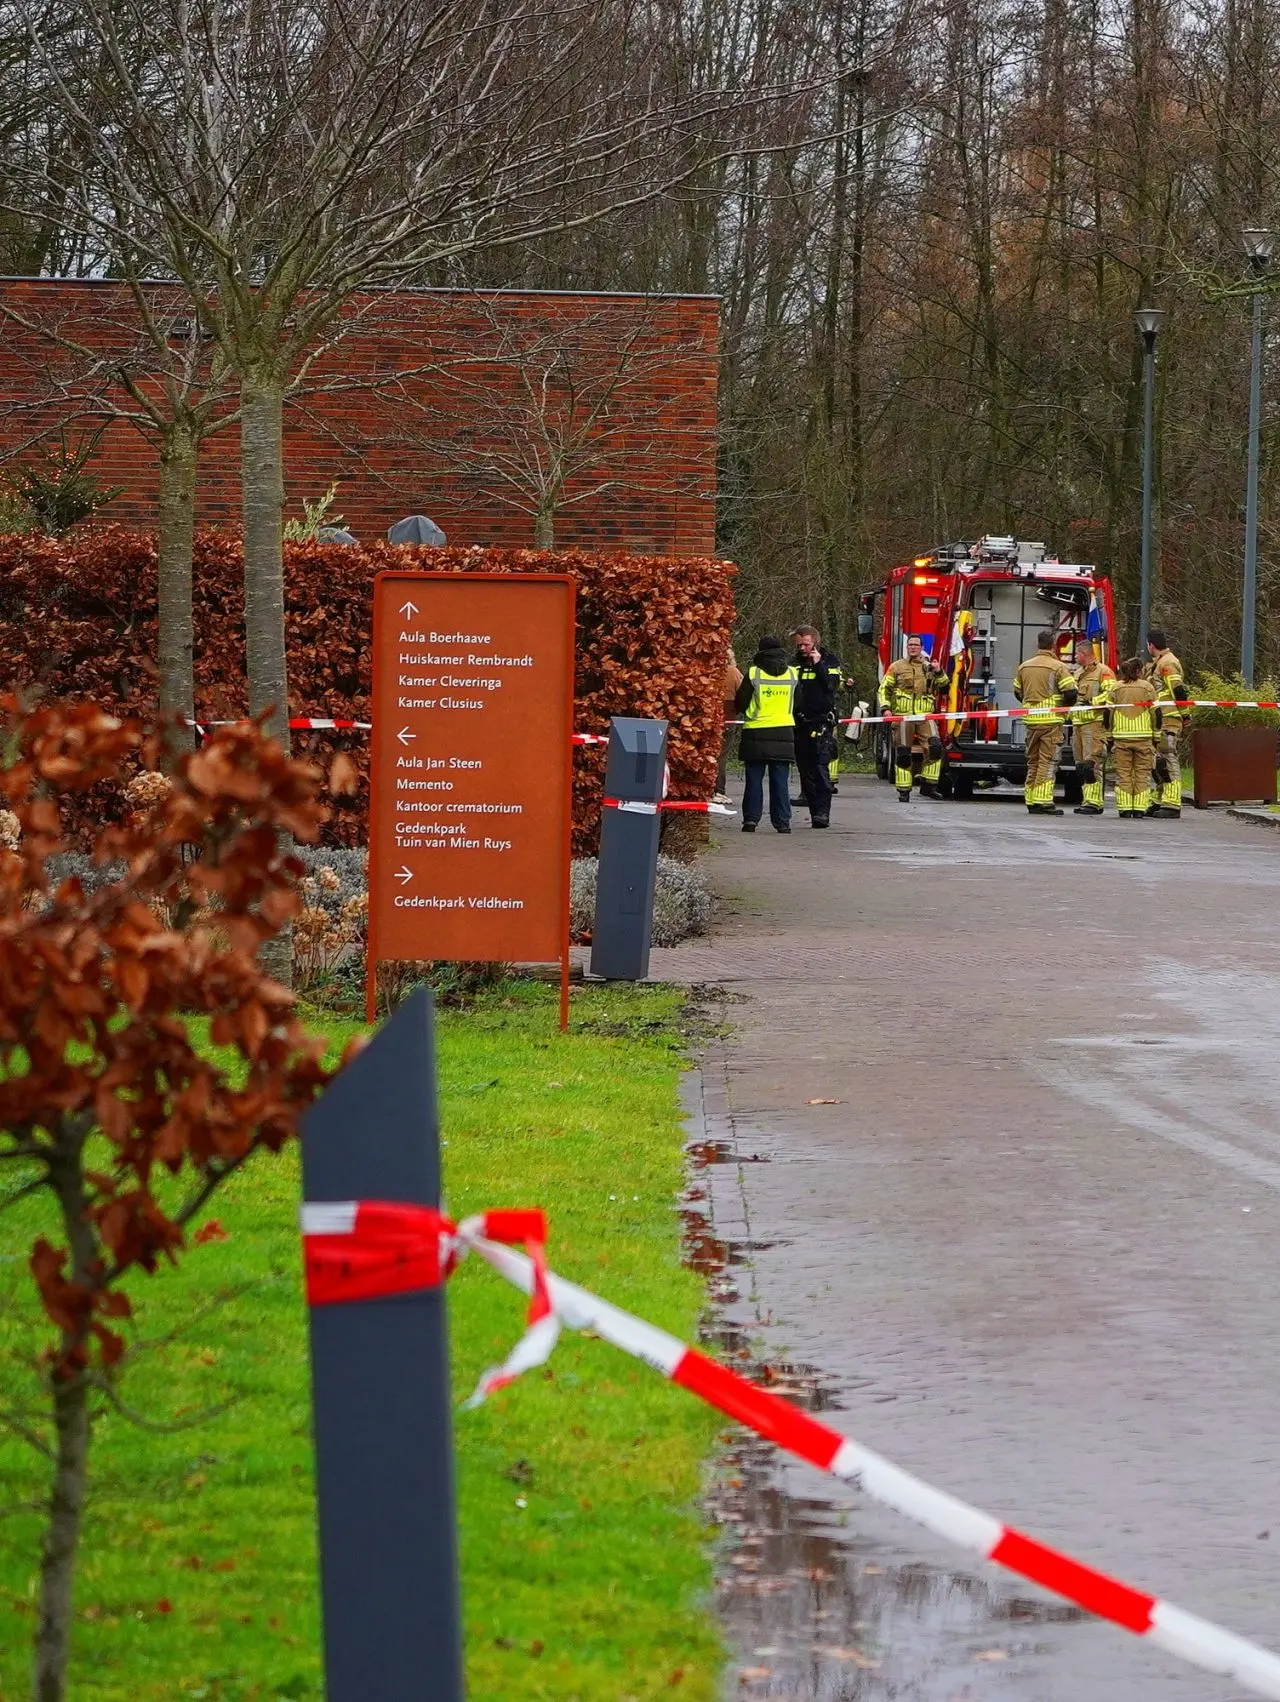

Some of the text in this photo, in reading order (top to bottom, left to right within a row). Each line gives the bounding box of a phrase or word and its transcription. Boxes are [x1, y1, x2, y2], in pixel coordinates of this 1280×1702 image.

[398, 630, 492, 644] Aula Boerhaave
[398, 652, 534, 667] Huiskamer Rembrandt
[398, 674, 502, 691] Kamer Cleveringa
[398, 696, 484, 710] Kamer Clusius
[396, 755, 482, 771] Aula Jan Steen
[396, 778, 454, 791] Memento
[396, 800, 523, 814] Kantoor crematorium
[395, 821, 467, 836] Gedenkpark
[394, 835, 512, 852] Tuin van Mien Ruys
[393, 895, 524, 911] Gedenkpark Veldheim
